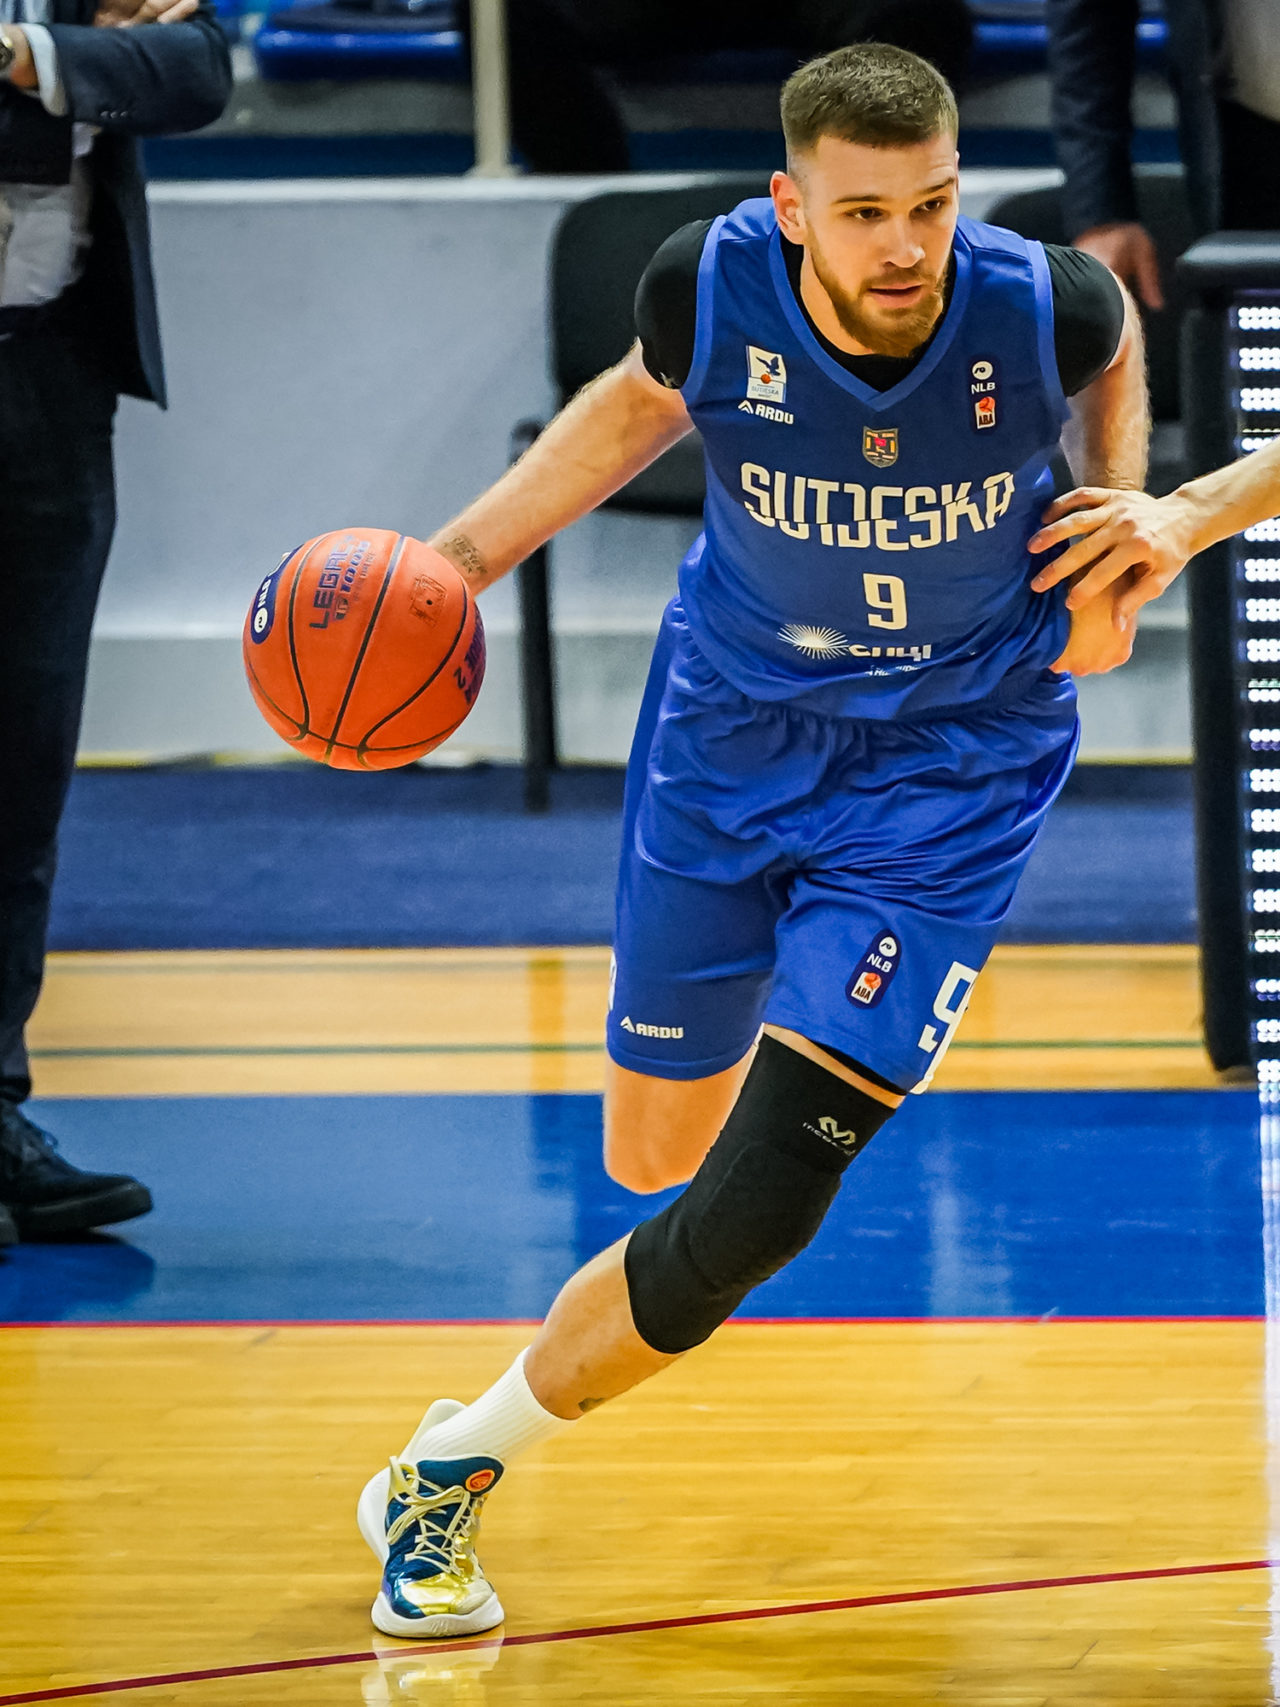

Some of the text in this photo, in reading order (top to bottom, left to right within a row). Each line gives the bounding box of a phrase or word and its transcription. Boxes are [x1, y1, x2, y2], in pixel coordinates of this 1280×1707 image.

[971, 382, 995, 395] NLB
[755, 403, 794, 425] ARDU
[979, 413, 993, 427] ABA
[740, 462, 1015, 551] SUTJESKA
[862, 572, 908, 631] 9
[866, 952, 893, 973] NLB
[918, 961, 979, 1054] 9
[636, 1022, 685, 1040] ARDU
